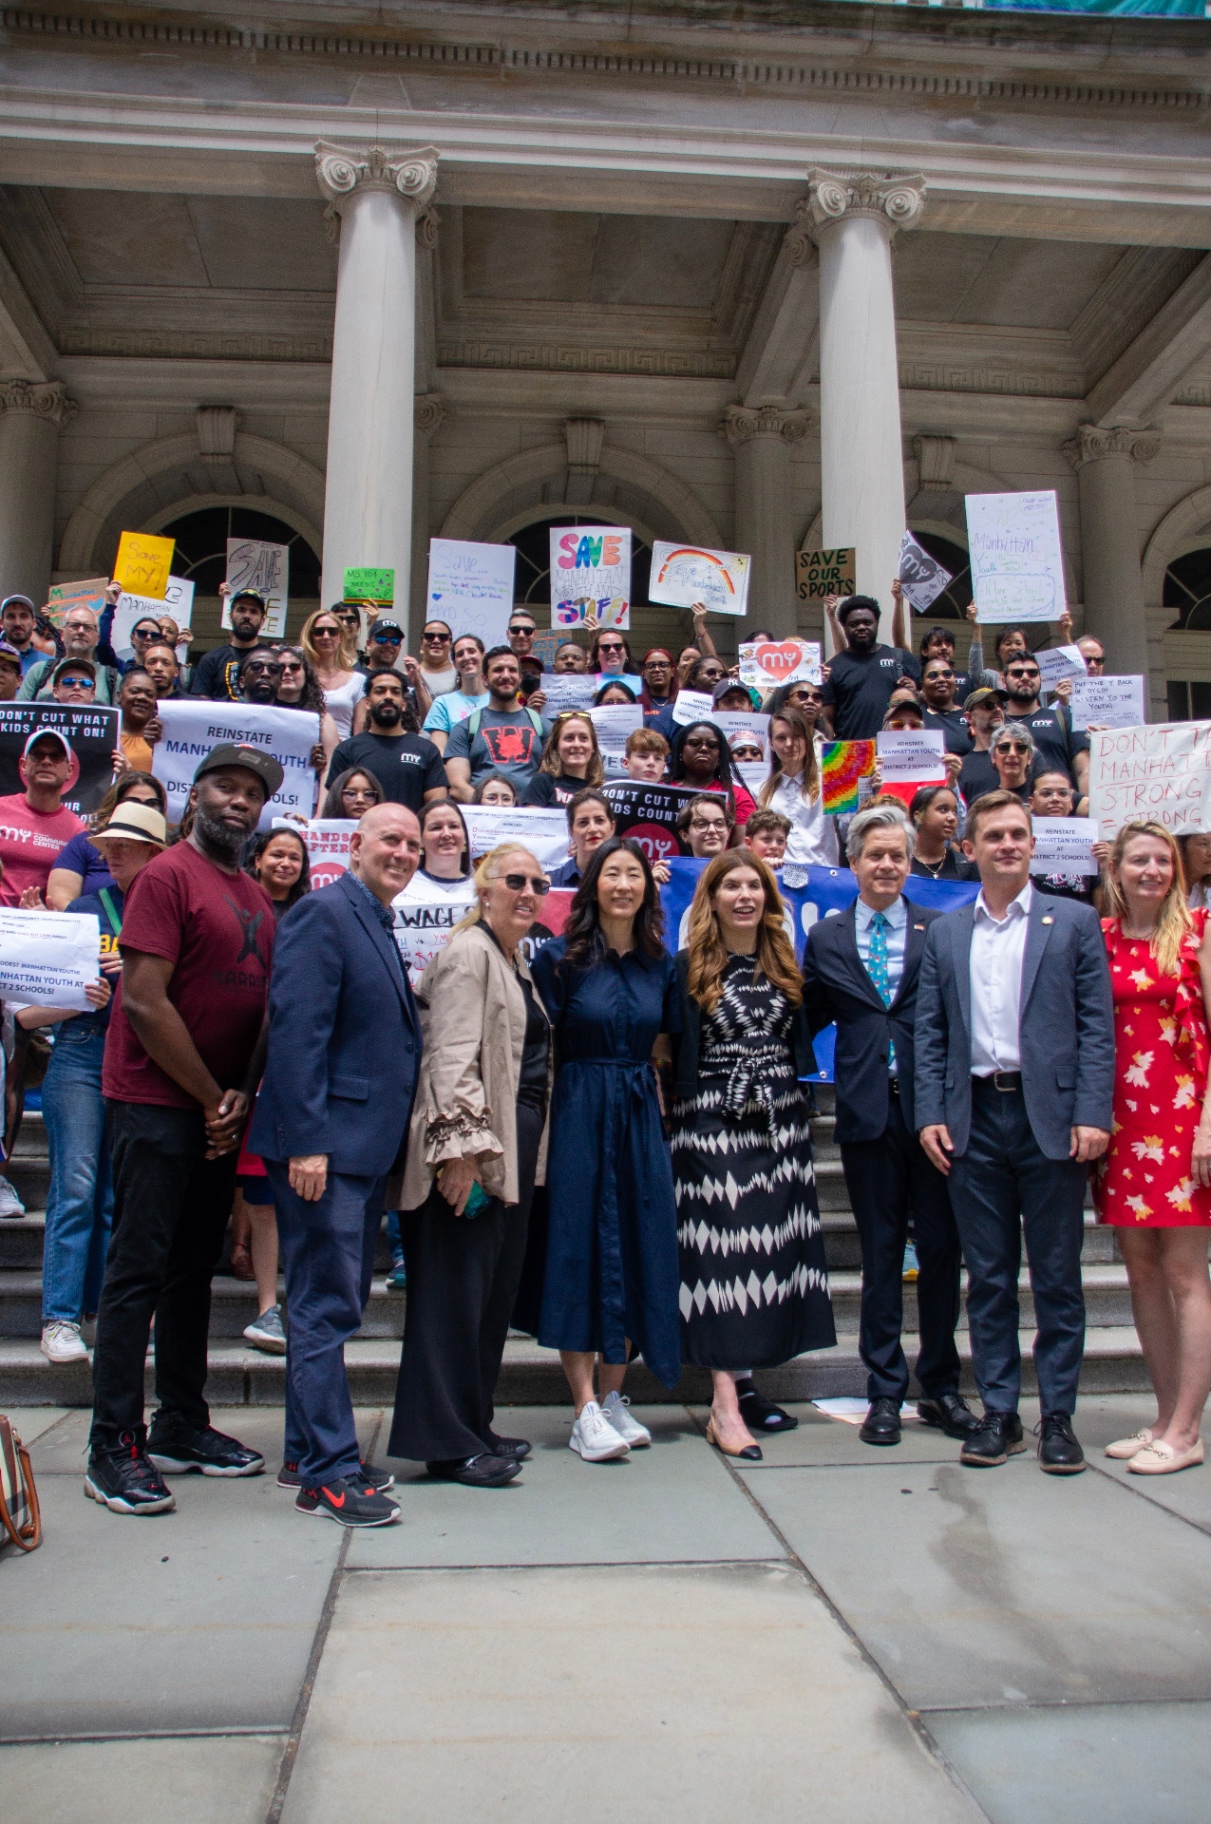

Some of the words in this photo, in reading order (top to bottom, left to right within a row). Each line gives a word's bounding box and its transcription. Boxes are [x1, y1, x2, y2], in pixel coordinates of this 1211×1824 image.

[126, 541, 161, 564] Save
[436, 544, 478, 573] Save
[558, 533, 623, 569] SAVE
[800, 549, 849, 568] SAVE
[229, 543, 282, 589] SAVE
[807, 567, 841, 581] OUR
[126, 564, 164, 591] MY!
[555, 567, 624, 588] MANHATTAN
[554, 585, 592, 600] YOUTH
[593, 585, 621, 599] AND
[799, 579, 855, 599] SPORTS
[556, 597, 628, 624] STAFF!
[41, 713, 66, 723] CUT
[72, 714, 109, 726] WHAT
[1, 723, 30, 733] KIDS
[83, 727, 105, 738] ON!
[207, 726, 273, 744] REINSTATE
[1099, 729, 1174, 757] DON'T
[644, 793, 671, 806] CUT
[1100, 778, 1202, 811] STRONG
[637, 807, 680, 822] COUNT
[33, 834, 69, 847] COMMUNI
[299, 830, 350, 843] HANDS
[32, 840, 60, 851] CENTER
[21, 963, 58, 973] MANHATTAN
[8, 983, 13, 991] 2
[15, 985, 55, 995] SCHOOLS!
[43, 976, 73, 987] YOUTH
